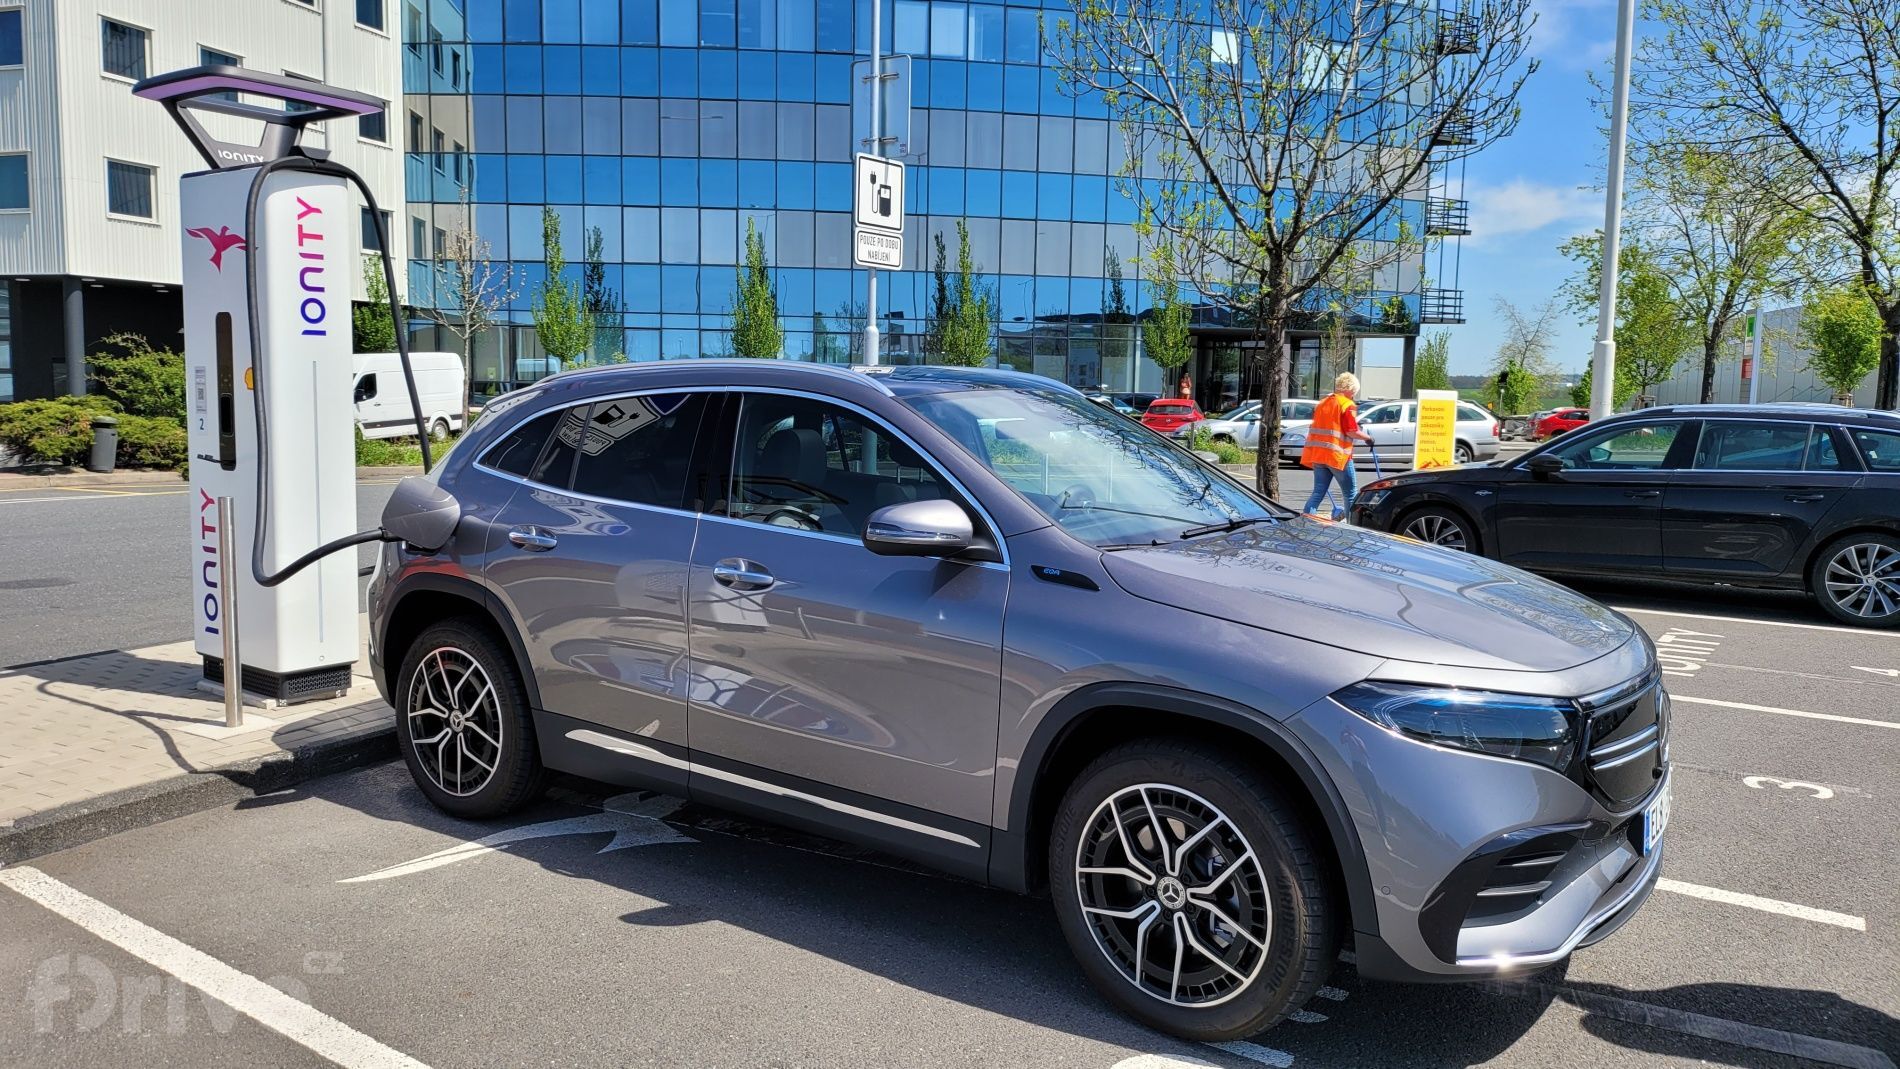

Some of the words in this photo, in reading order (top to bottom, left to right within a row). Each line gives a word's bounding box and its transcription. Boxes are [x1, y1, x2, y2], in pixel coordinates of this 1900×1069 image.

[217, 149, 264, 163] IONITY
[860, 234, 876, 246] POUZE
[877, 237, 884, 248] PO
[885, 238, 899, 250] DOBU
[296, 195, 327, 336] IONITY
[199, 418, 204, 431] 2
[200, 487, 219, 635] IONITY
[1742, 775, 1834, 800] 3
